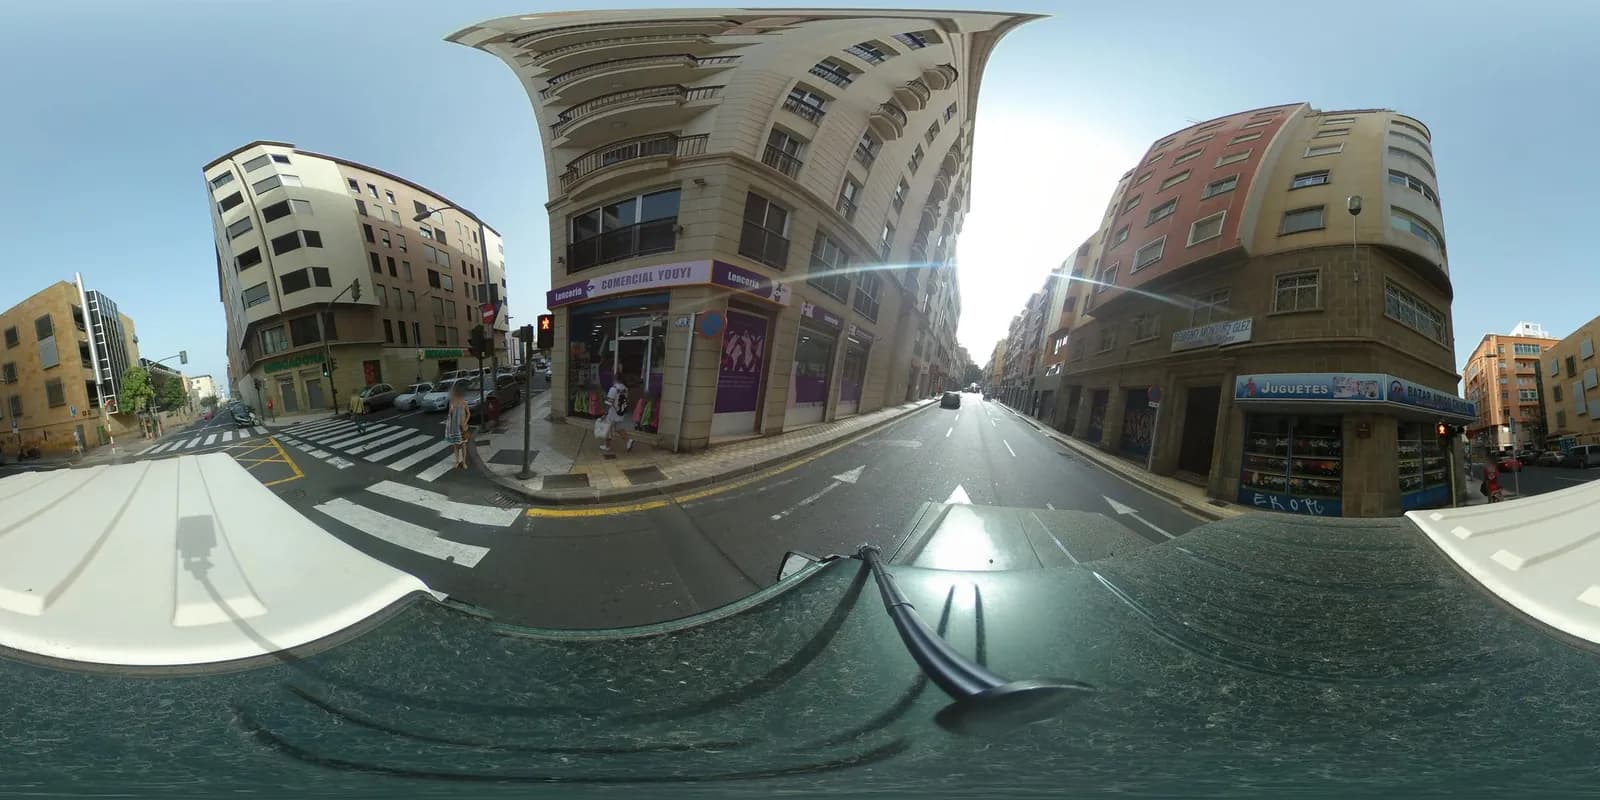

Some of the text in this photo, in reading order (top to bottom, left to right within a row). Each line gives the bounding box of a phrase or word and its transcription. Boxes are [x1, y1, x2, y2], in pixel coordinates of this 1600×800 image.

[601, 267, 691, 291] COMERCIAL YOUYI
[1407, 386, 1432, 401] BAZAR
